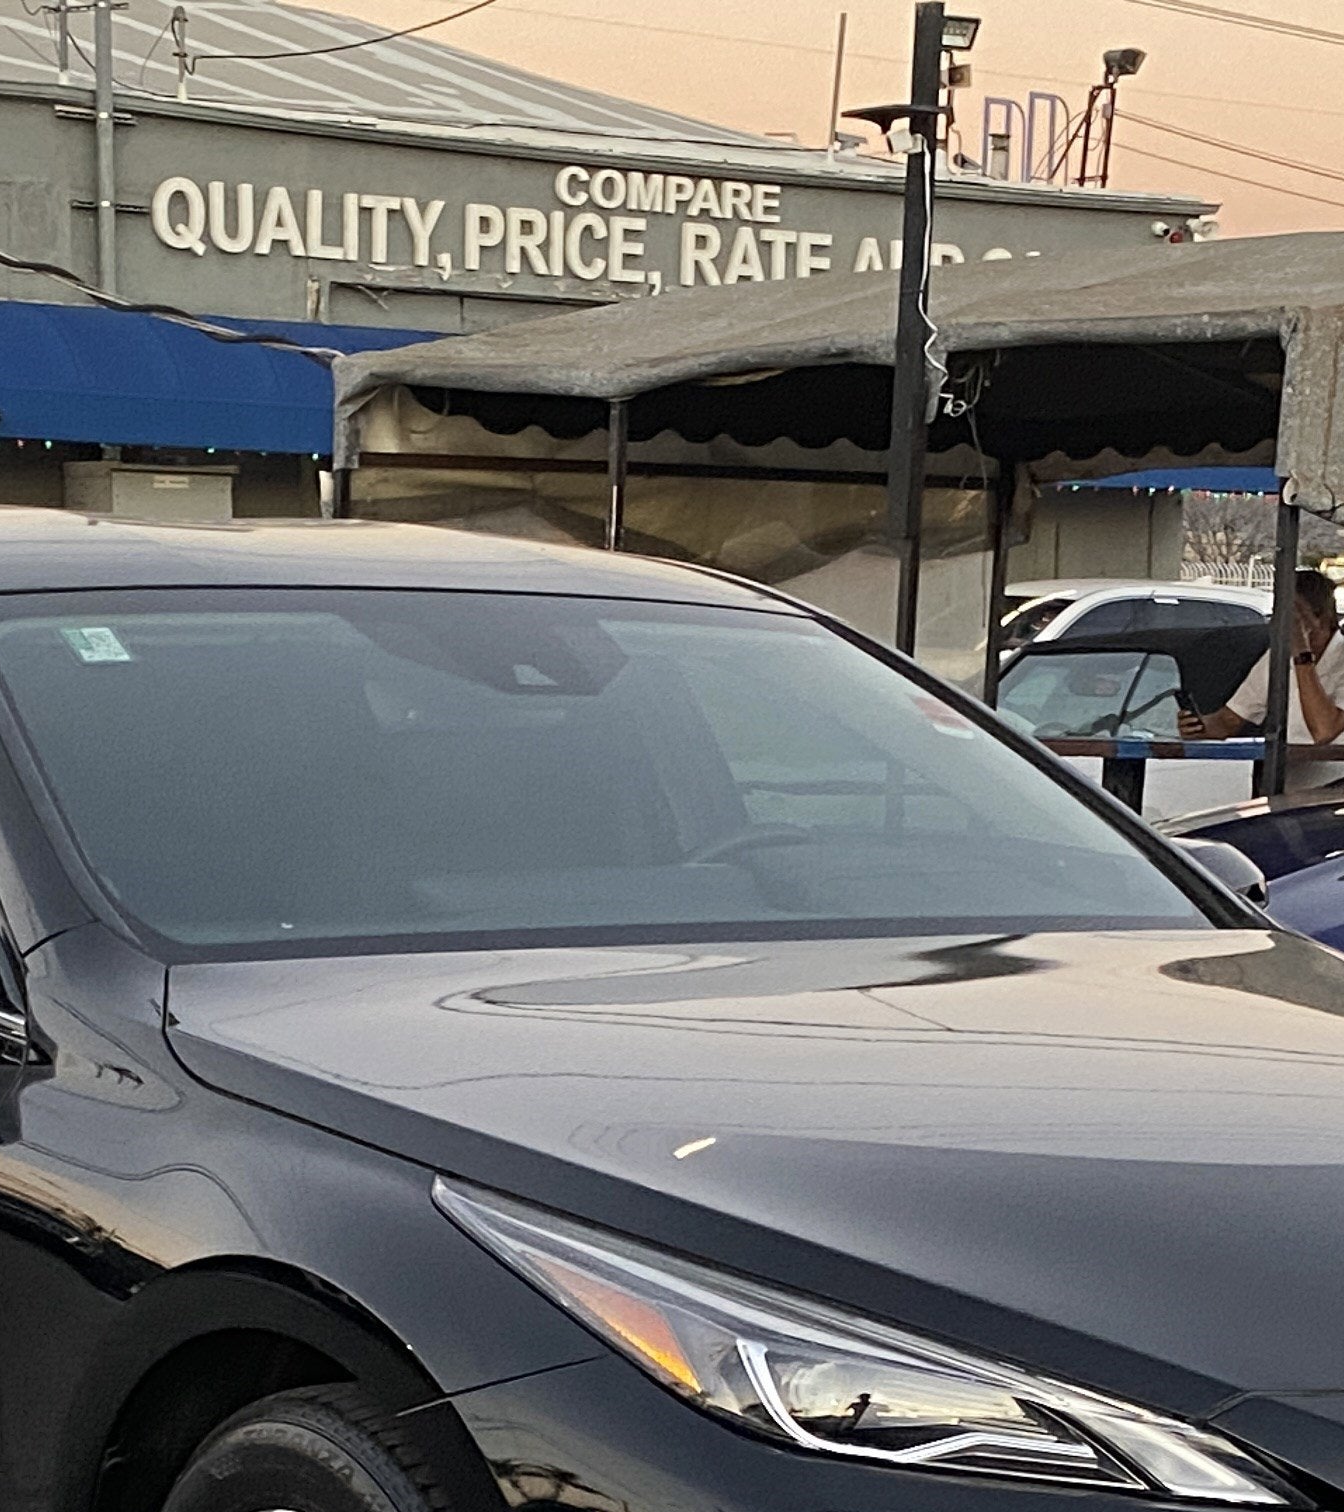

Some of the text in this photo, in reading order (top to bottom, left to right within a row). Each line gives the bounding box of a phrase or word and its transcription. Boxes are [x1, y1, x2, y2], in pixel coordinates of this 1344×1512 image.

[151, 176, 833, 296] QUALITY, PRICE, RATE
[555, 165, 781, 223] COMPARE
